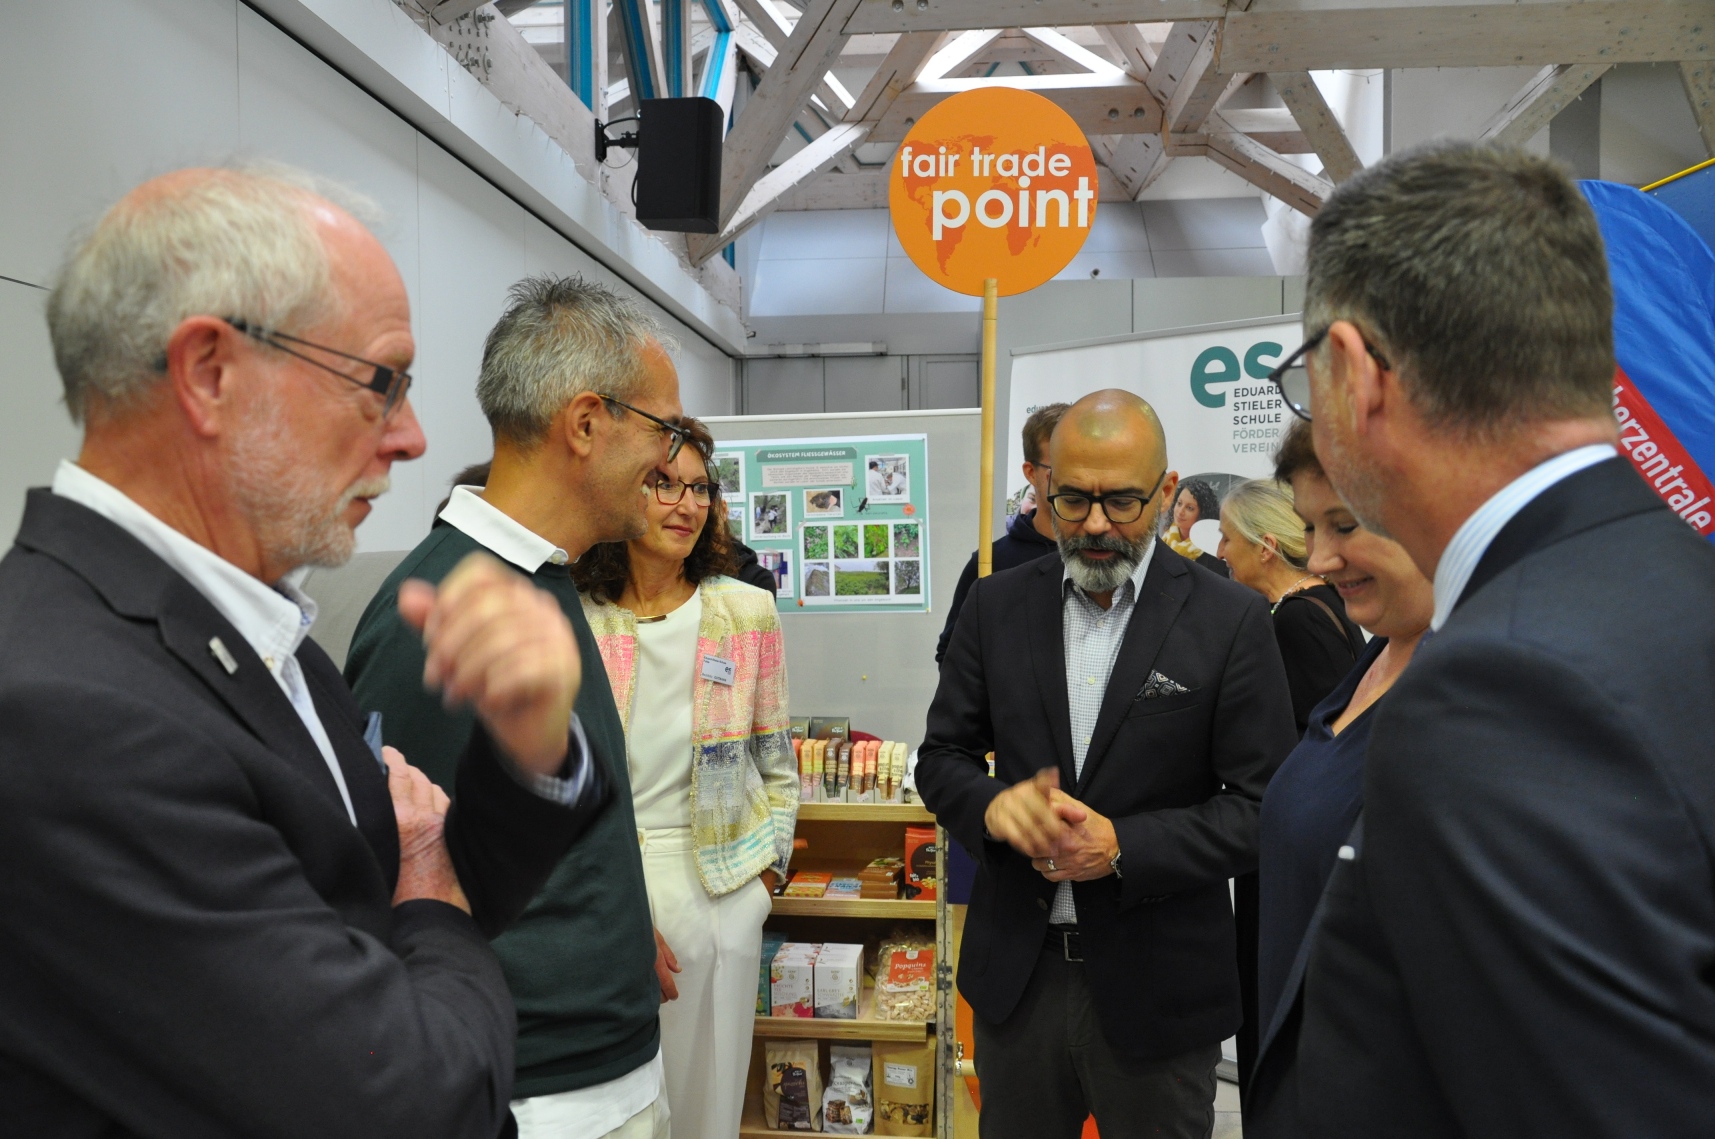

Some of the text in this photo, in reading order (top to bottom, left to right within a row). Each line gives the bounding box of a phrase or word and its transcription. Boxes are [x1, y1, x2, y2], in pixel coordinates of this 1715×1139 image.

[901, 145, 1072, 178] fair trade
[932, 175, 1094, 241] point
[1190, 341, 1283, 409] es
[1234, 385, 1283, 398] EDUARD
[1233, 399, 1283, 412] STIELER
[1233, 413, 1282, 426] SCHULE
[1232, 427, 1280, 440] FÖRDER
[767, 449, 846, 459] ÖKOSYSTEM FLIESSGEWÄSSER
[1232, 442, 1281, 454] VEREIN
